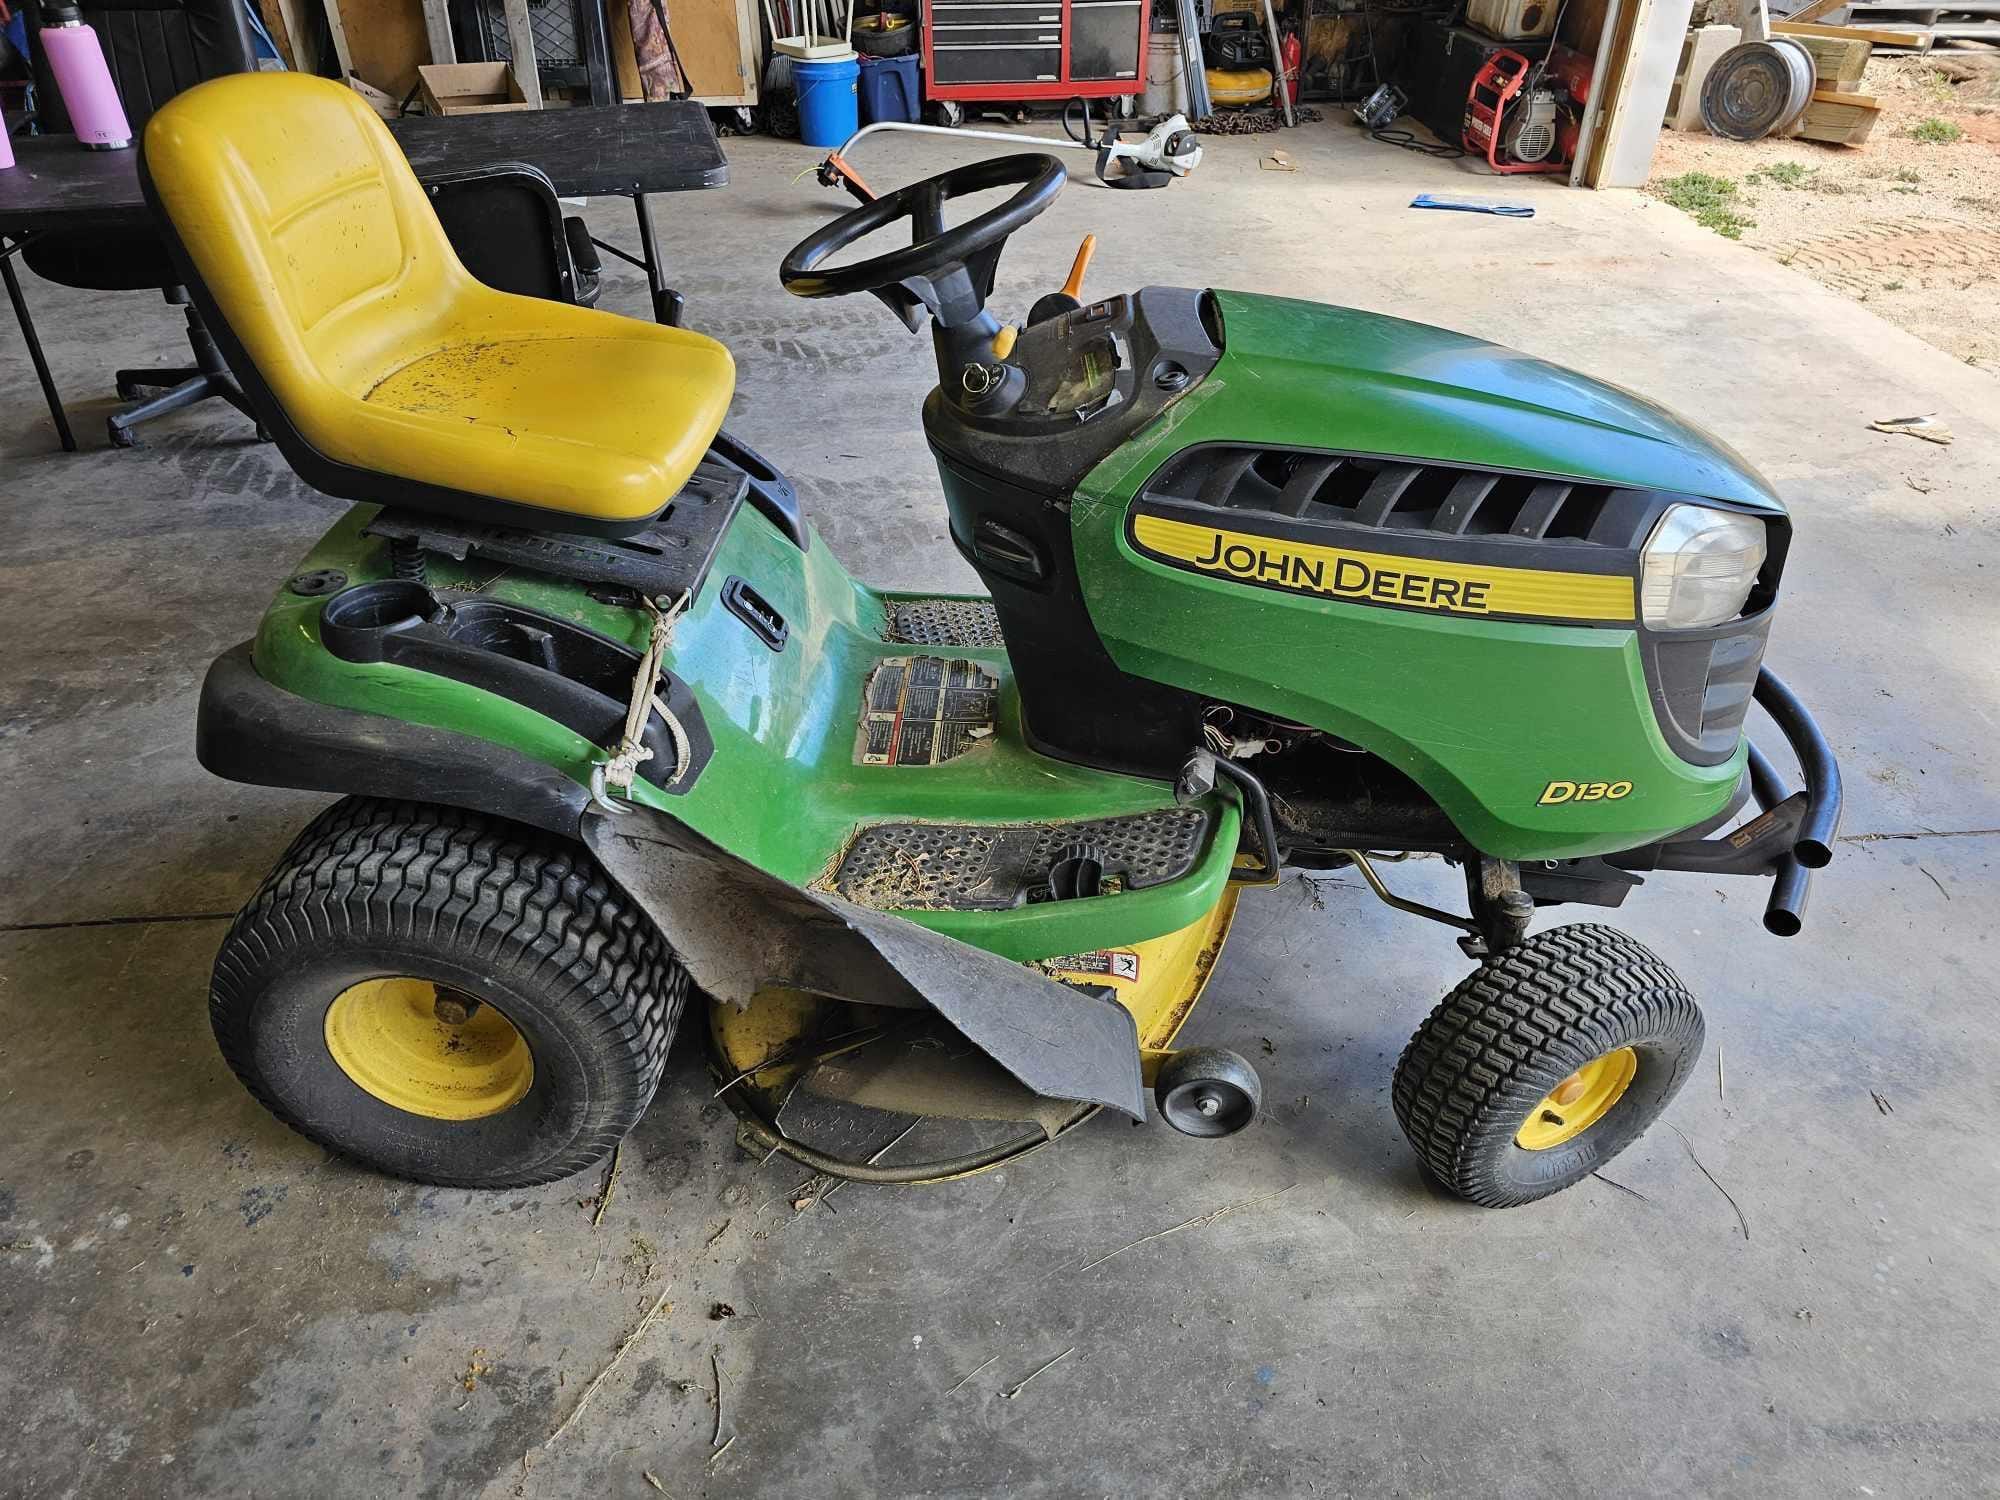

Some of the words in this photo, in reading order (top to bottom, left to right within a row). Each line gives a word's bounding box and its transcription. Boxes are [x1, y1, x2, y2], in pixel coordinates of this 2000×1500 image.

[1195, 534, 1325, 588] JOHN
[1333, 557, 1491, 609] DEERE
[1537, 781, 1633, 805] D130
